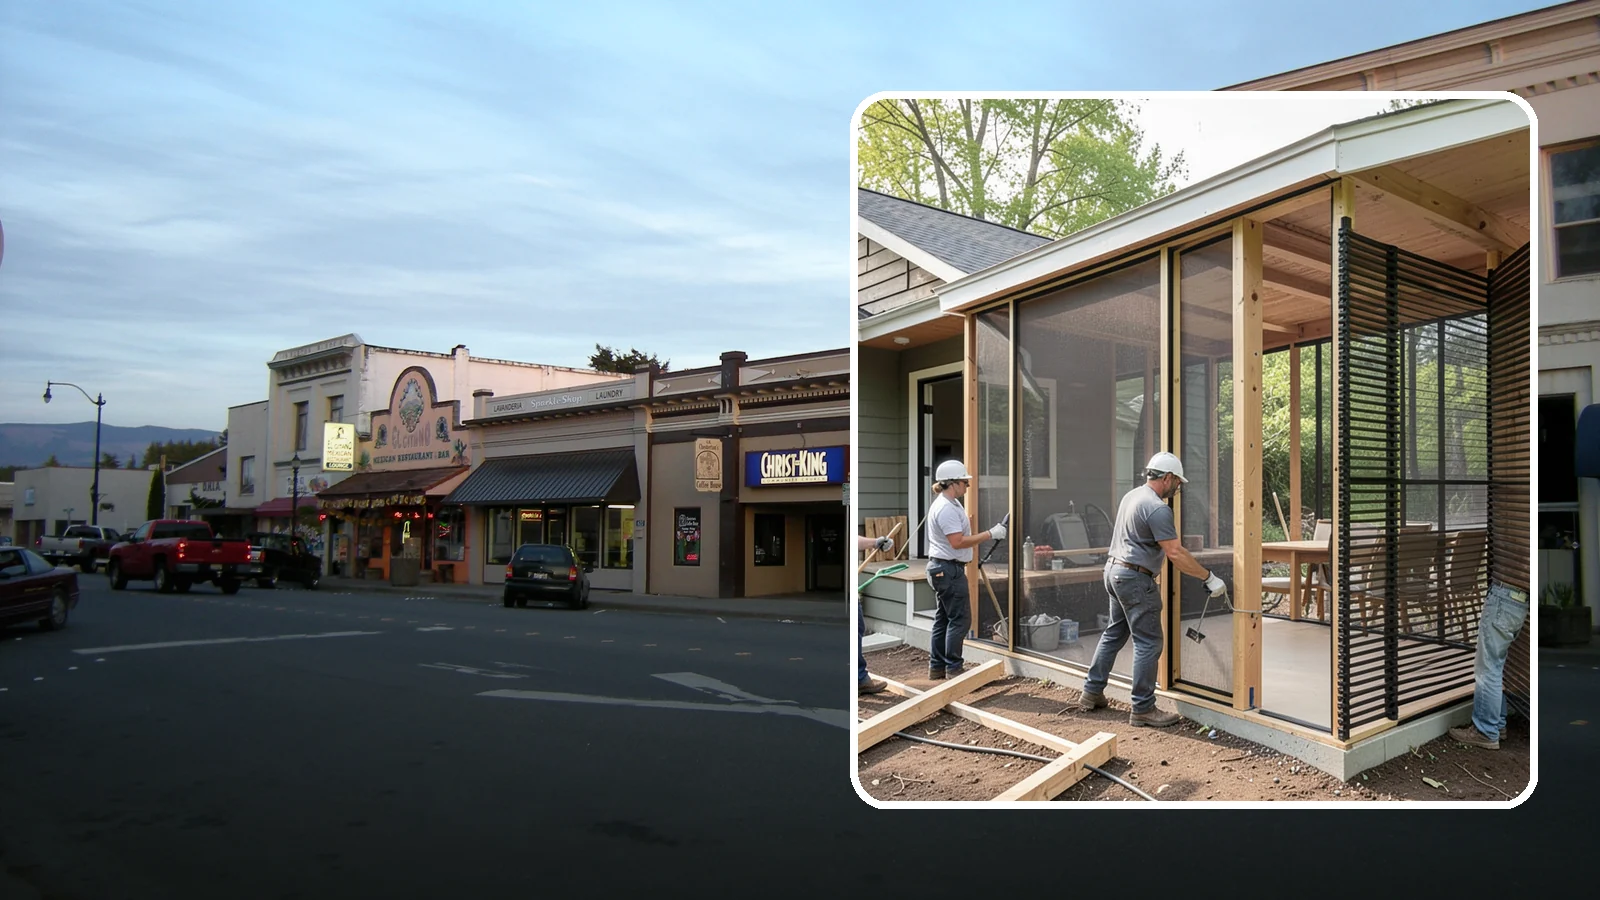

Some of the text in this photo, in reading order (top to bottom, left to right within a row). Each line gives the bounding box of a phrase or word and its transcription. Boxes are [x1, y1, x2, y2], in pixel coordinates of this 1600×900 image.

[595, 388, 624, 400] LAUNDRY
[493, 401, 522, 412] LAVANDERIA
[530, 394, 582, 410] Sparkle Shop
[391, 425, 402, 450] EL
[373, 455, 396, 464] MEXICAN
[397, 452, 434, 463] RESTAURANT
[438, 450, 450, 459] BAR
[760, 449, 828, 478] CHRIST KING
